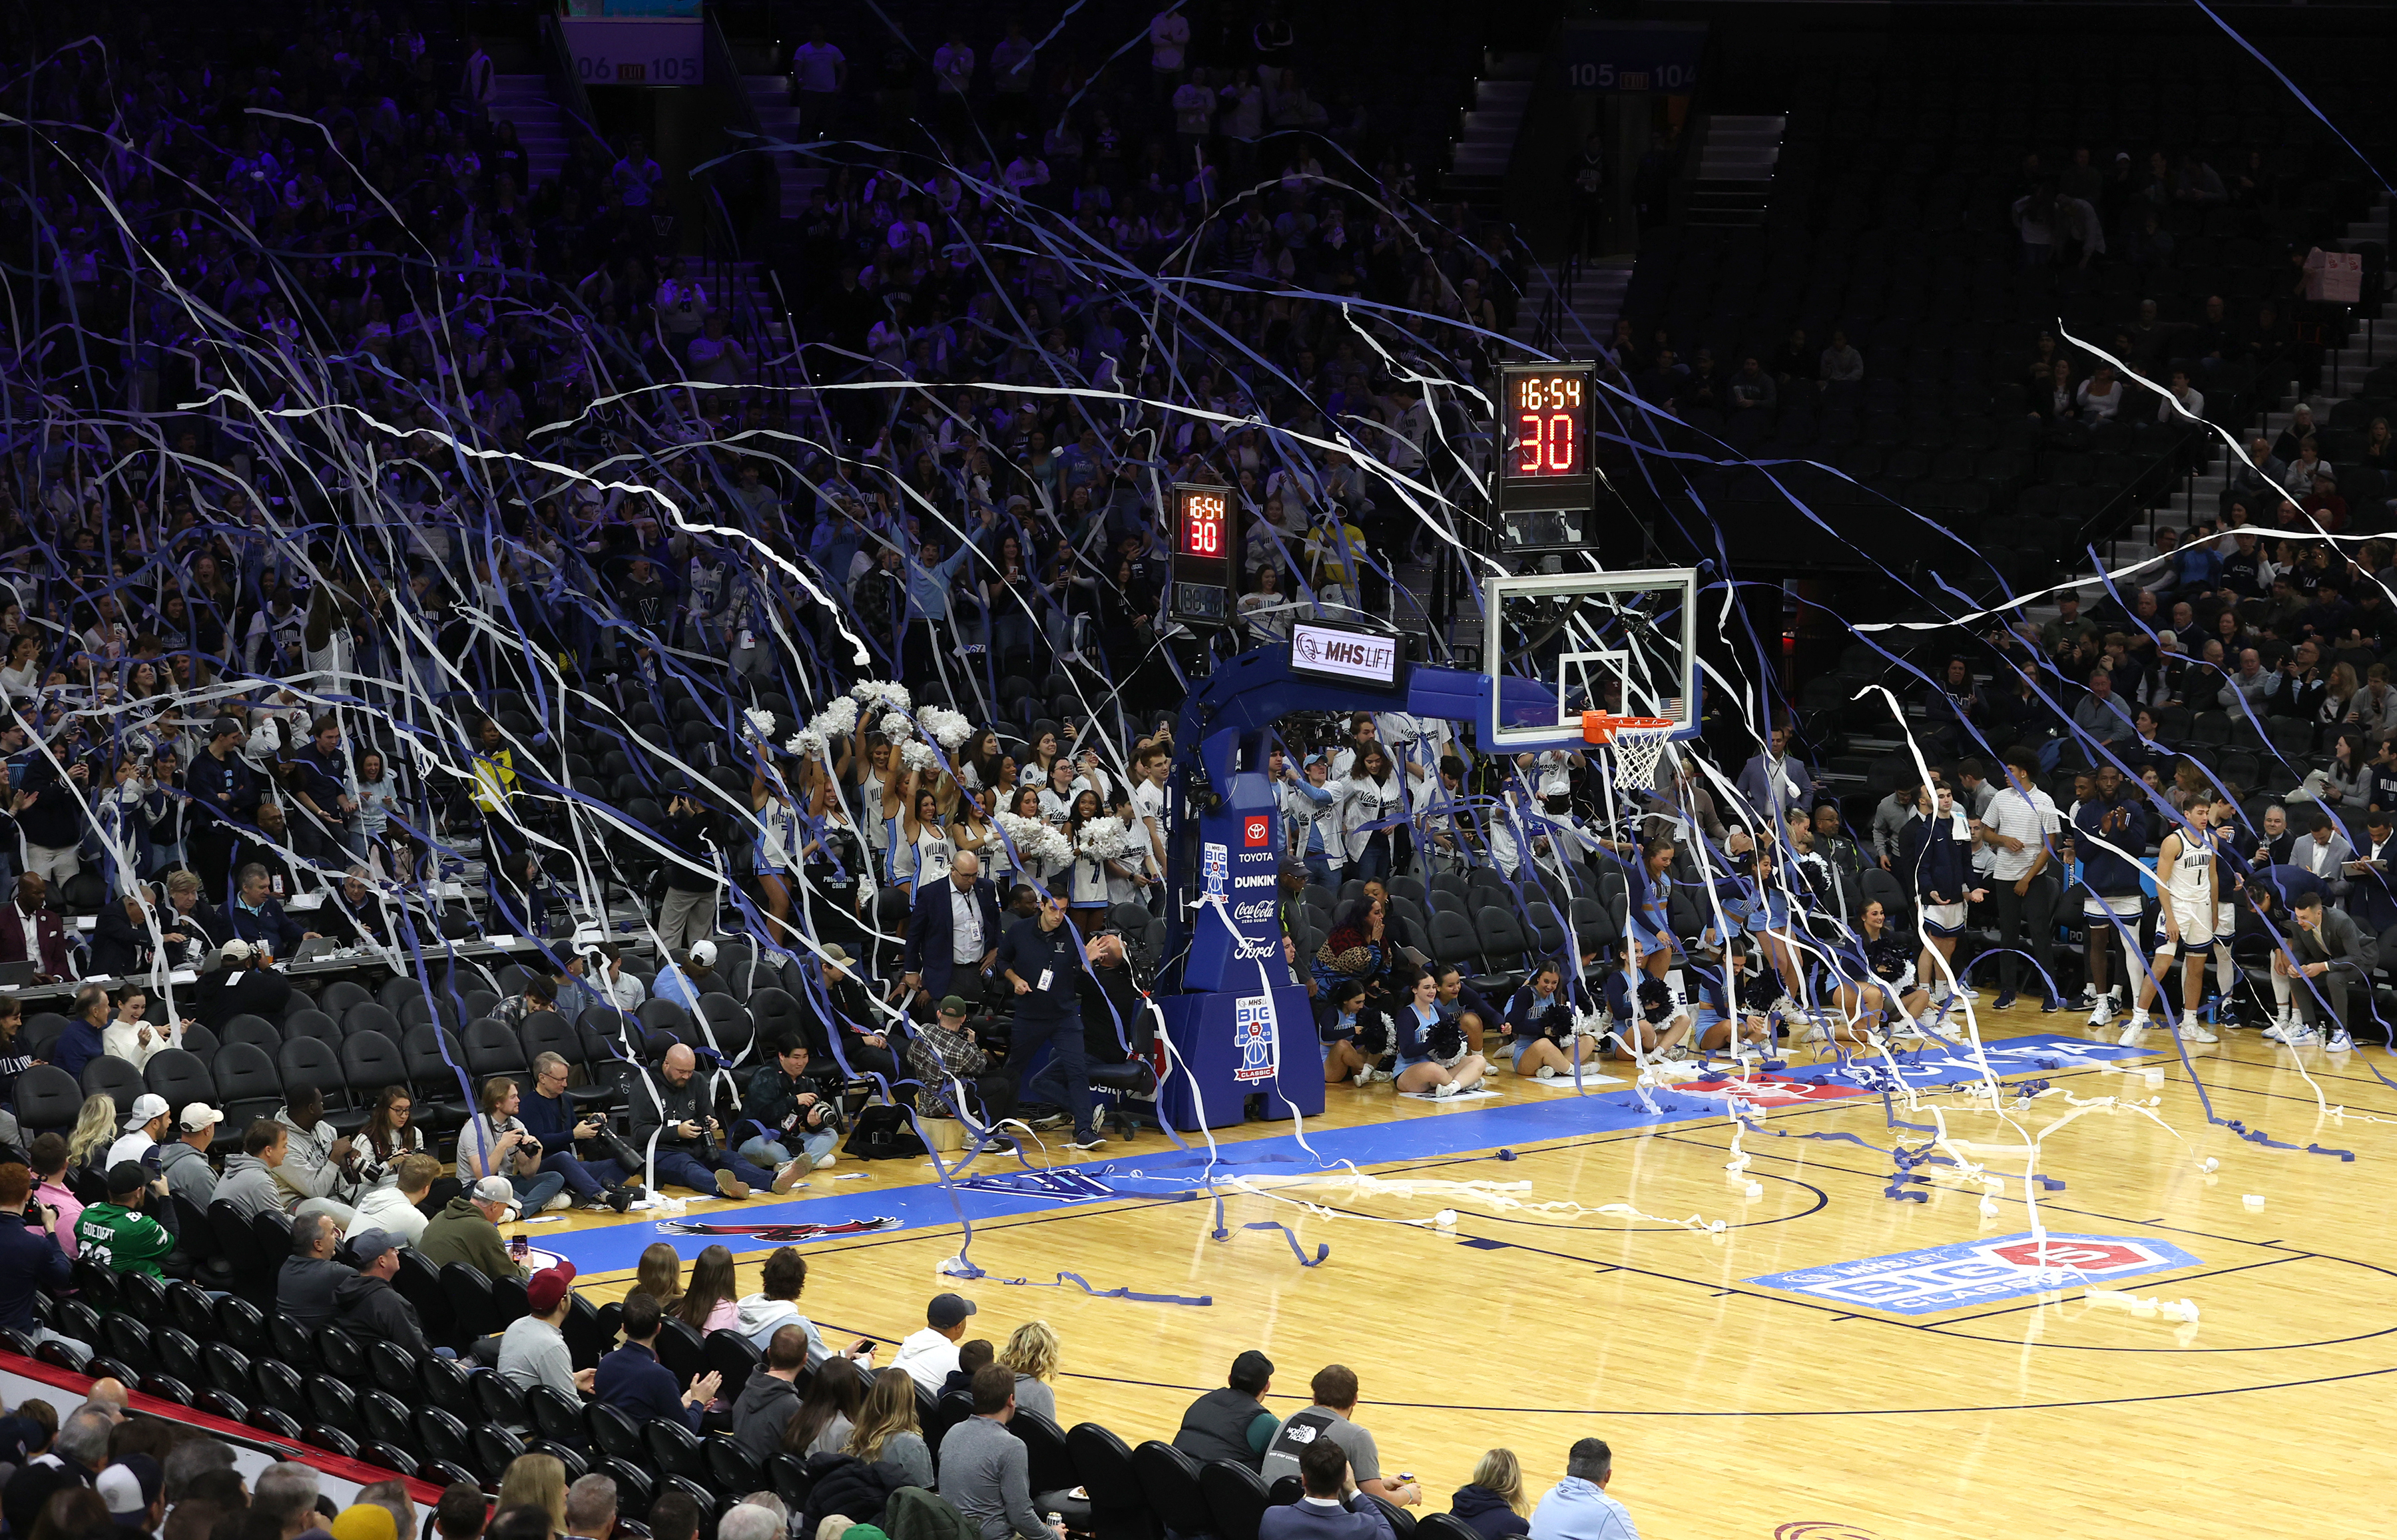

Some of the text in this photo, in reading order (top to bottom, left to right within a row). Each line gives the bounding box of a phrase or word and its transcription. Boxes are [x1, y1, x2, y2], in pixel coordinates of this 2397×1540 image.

[622, 65, 642, 79] EXIT
[653, 59, 696, 79] 105
[1570, 64, 1614, 87] 105
[1624, 74, 1645, 88] EXIT
[1521, 378, 1581, 409] 16:54
[1521, 413, 1573, 471] 30
[1189, 497, 1224, 519] 16:54
[1191, 521, 1217, 551] 30
[1325, 641, 1393, 670] MHS LIFT
[1205, 852, 1226, 862] BIG
[1238, 852, 1273, 863] TOYOTA
[1234, 874, 1277, 889] DUNKIN'
[1234, 936, 1277, 960] Ford
[1238, 1007, 1270, 1023] BIG
[1242, 1069, 1271, 1078] CLASSIC
[83, 1221, 116, 1242] GOEDERT
[1892, 1272, 2080, 1309] CLASSC
[1287, 1427, 1308, 1437] NORTH
